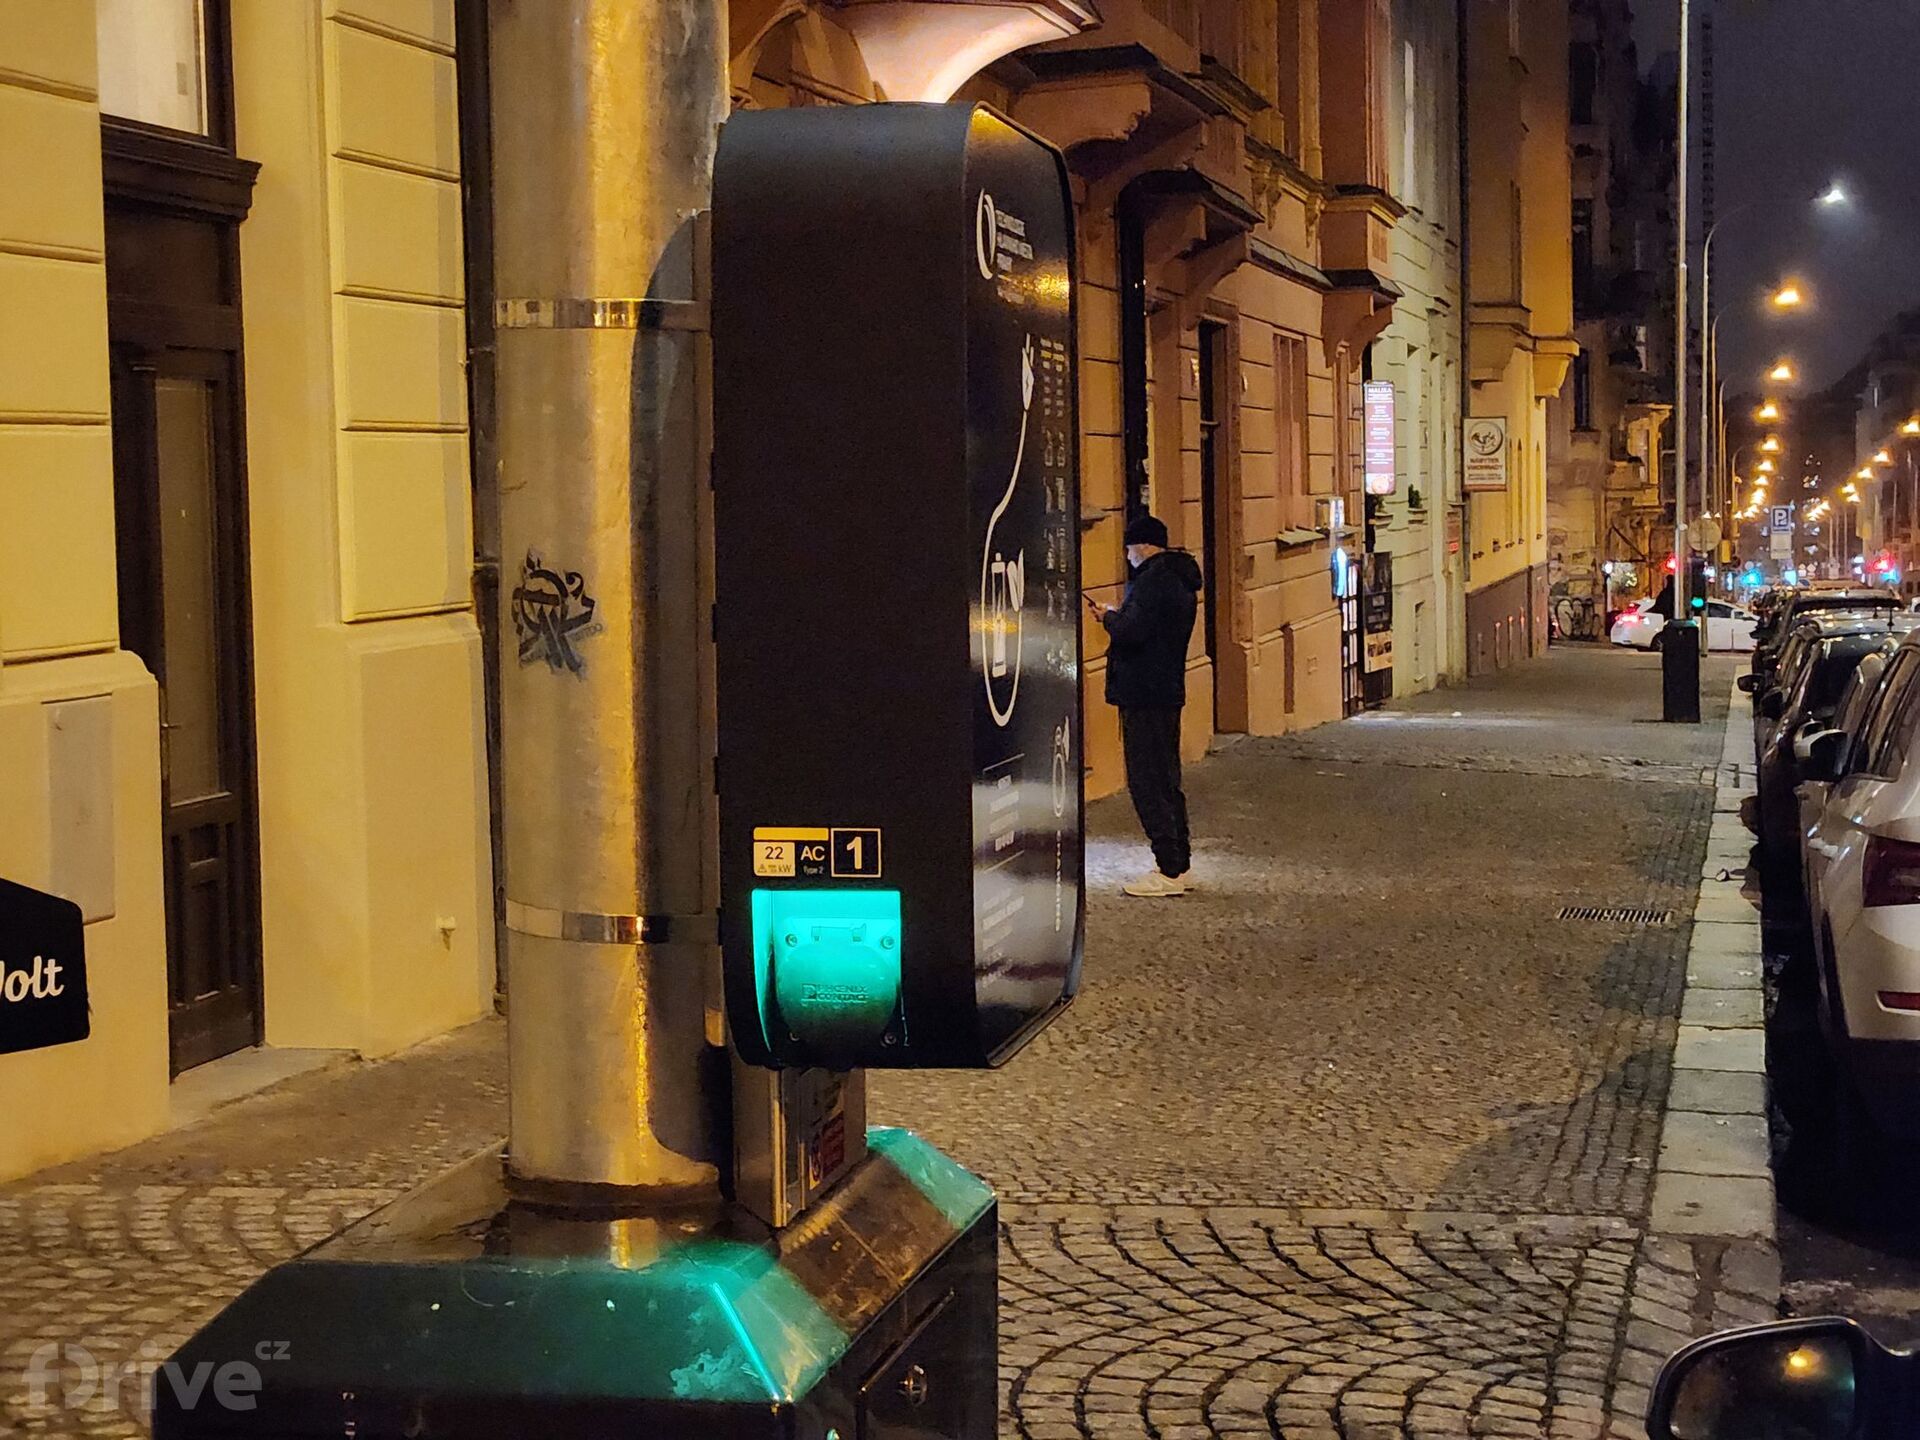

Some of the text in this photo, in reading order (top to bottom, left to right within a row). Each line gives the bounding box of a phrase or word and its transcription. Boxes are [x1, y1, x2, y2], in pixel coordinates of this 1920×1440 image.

[765, 846, 784, 860] 22
[800, 845, 825, 861] AC
[846, 836, 862, 870] 1
[0, 955, 64, 1002] olt
